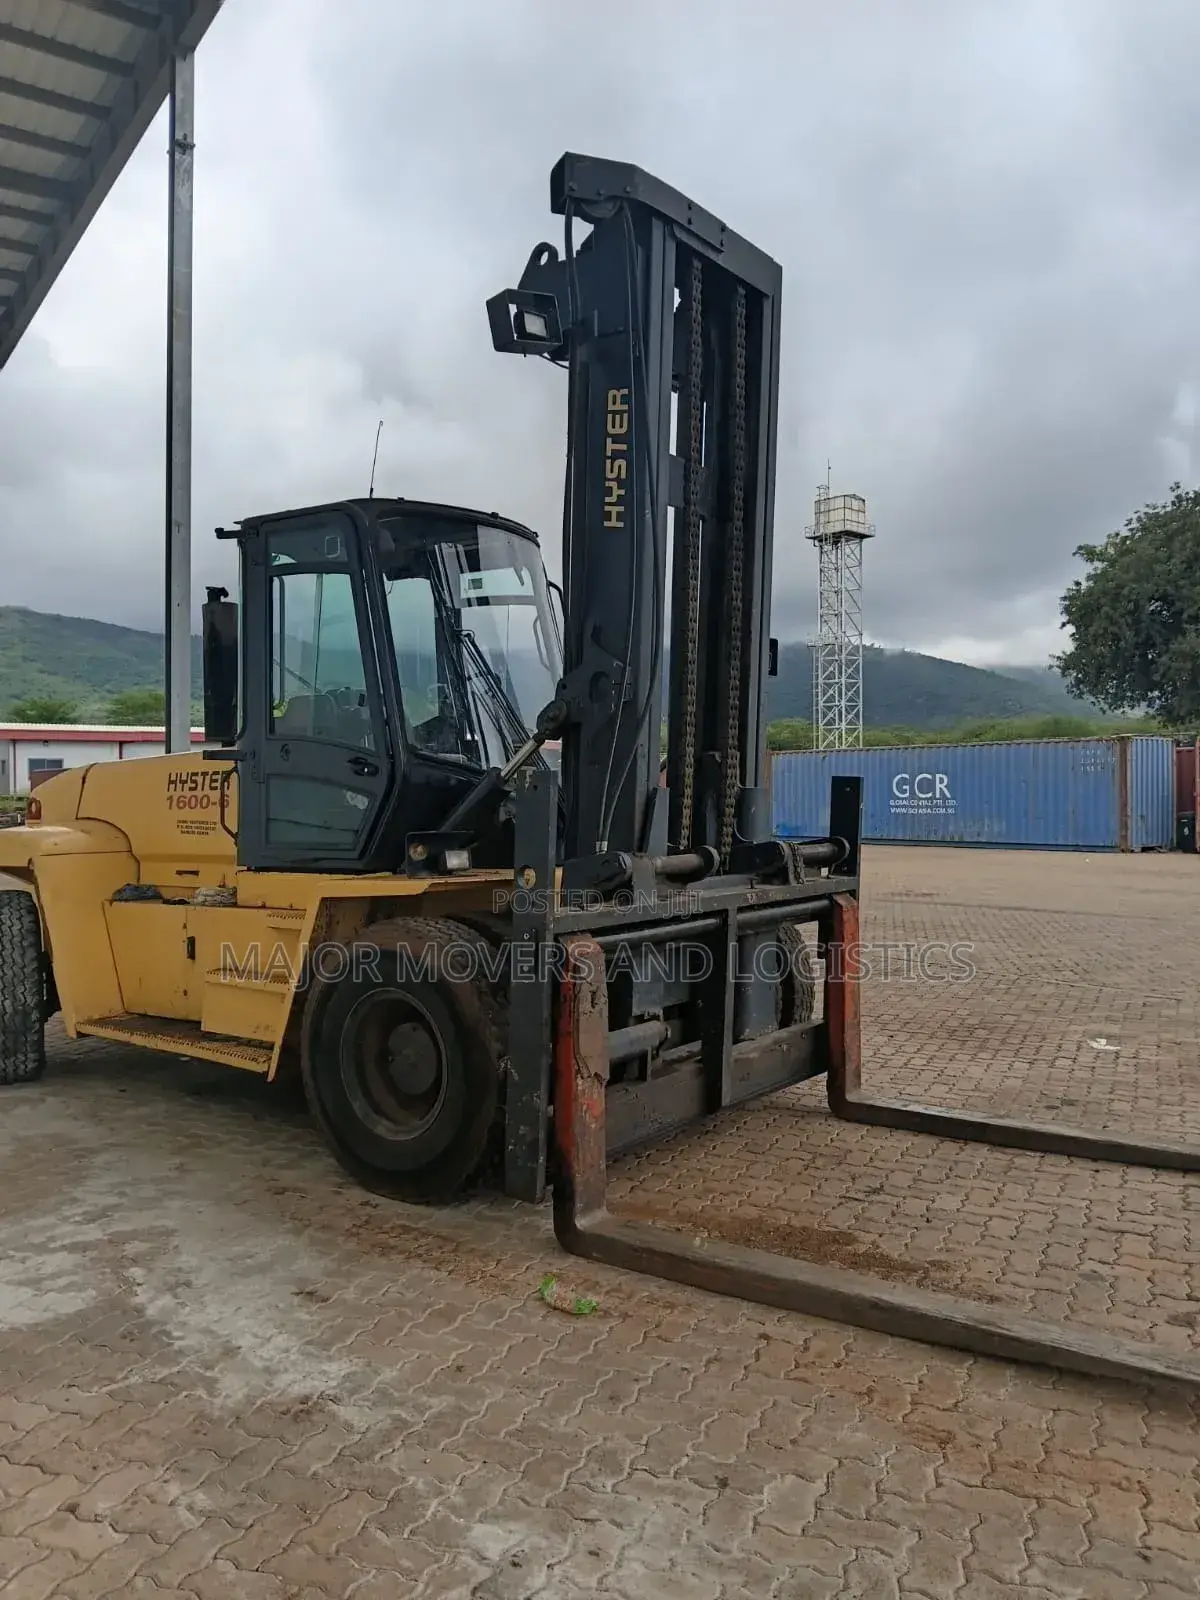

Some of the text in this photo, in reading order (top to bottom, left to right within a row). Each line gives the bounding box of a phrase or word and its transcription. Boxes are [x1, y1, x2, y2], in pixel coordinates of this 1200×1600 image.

[603, 388, 629, 528] HYSTER
[167, 770, 230, 792] HYSTER
[892, 773, 951, 798] GCR
